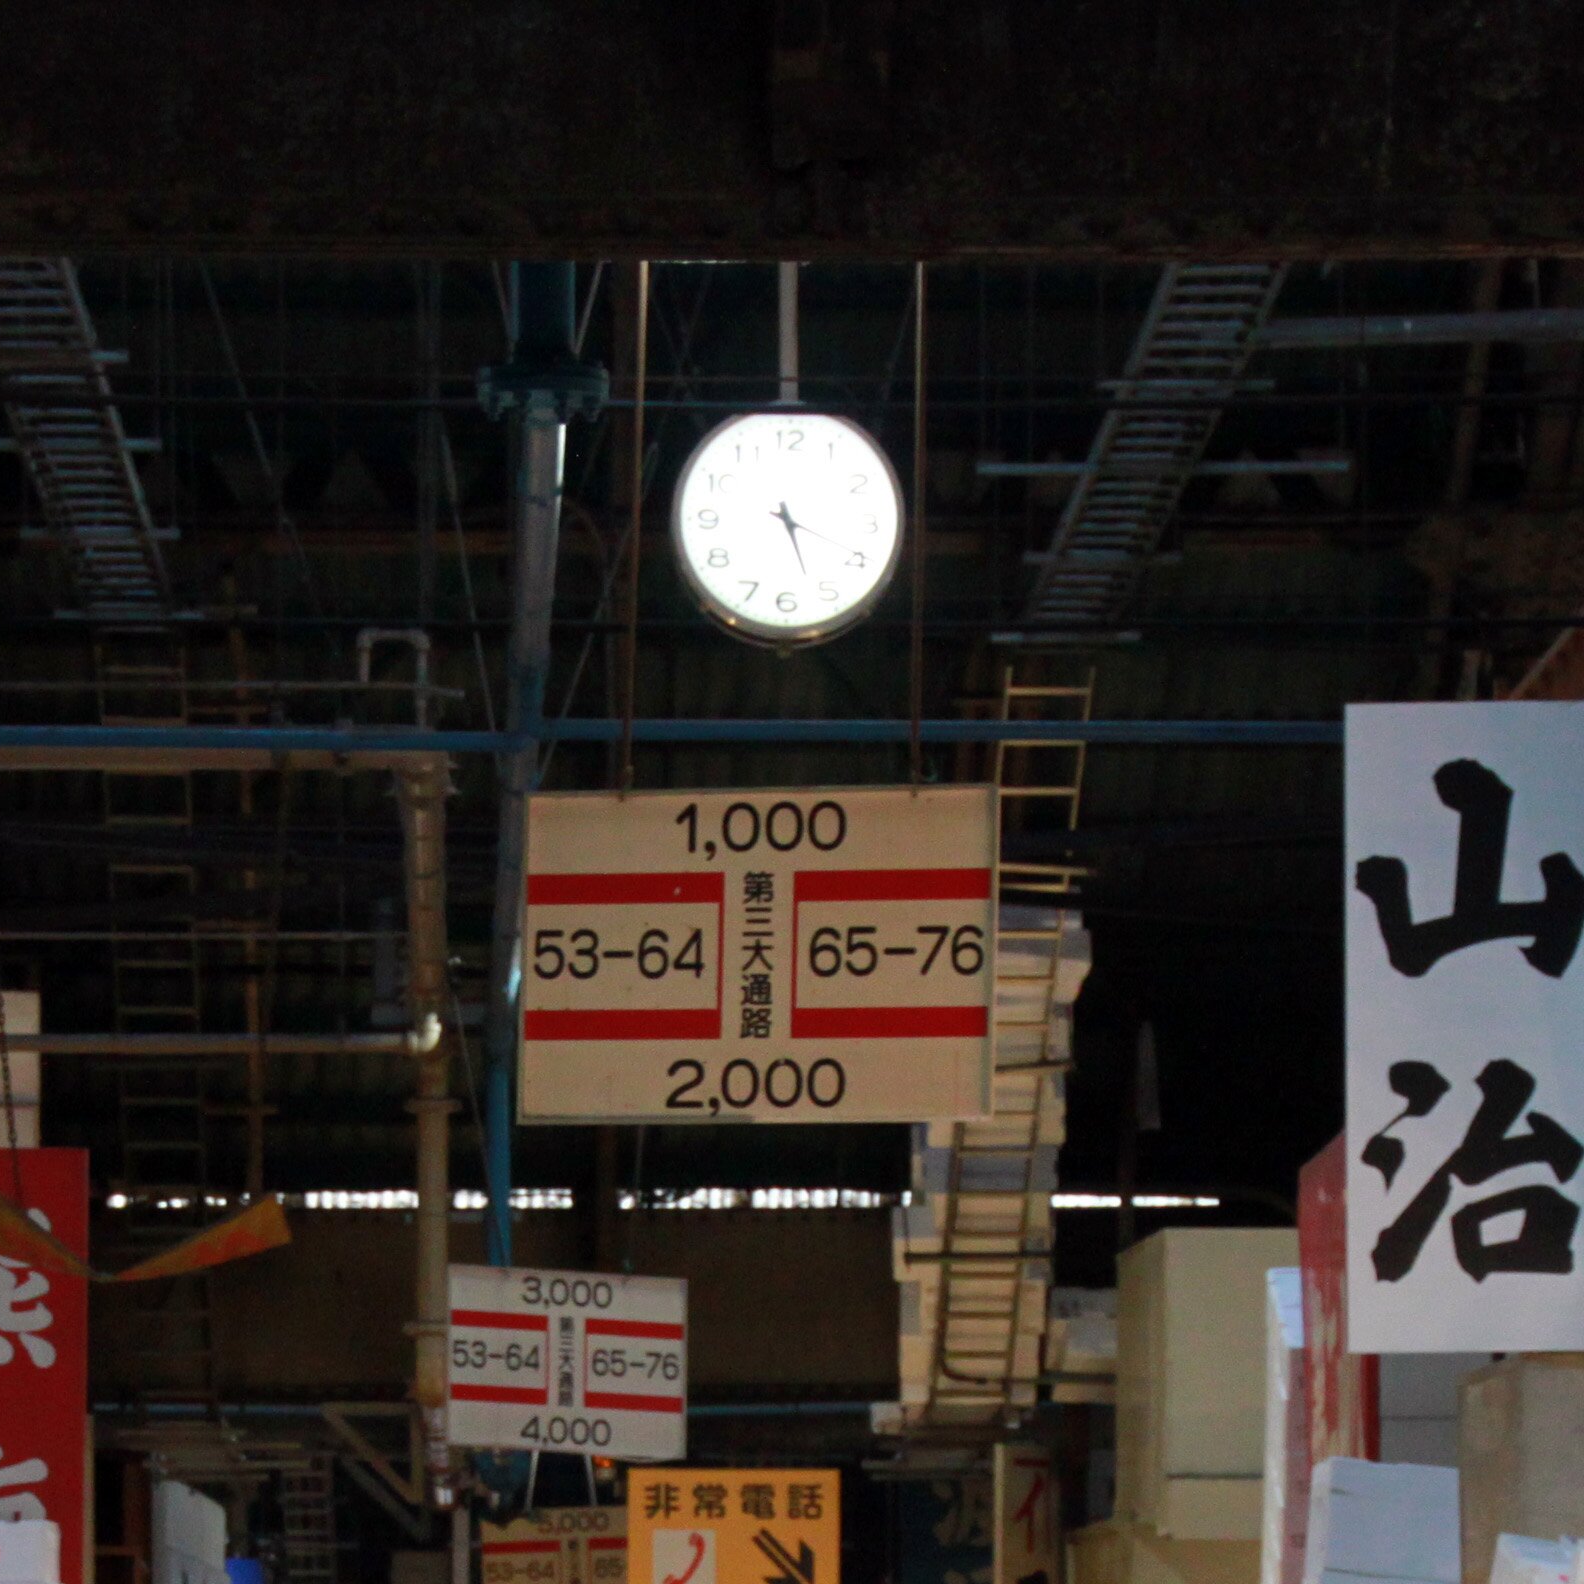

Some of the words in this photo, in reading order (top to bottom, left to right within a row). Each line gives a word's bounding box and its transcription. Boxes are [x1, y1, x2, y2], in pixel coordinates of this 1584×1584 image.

[735, 444, 760, 464] 11
[775, 429, 805, 452] 12
[827, 442, 834, 461] 1
[849, 474, 869, 494] 2
[697, 509, 720, 530] 9
[863, 513, 879, 534] 3
[707, 547, 730, 568] 8
[737, 580, 760, 602] 7
[775, 591, 798, 613] 6
[818, 580, 839, 602] 5
[674, 801, 848, 860] 1,000
[533, 927, 706, 980] 53-64
[741, 870, 775, 1040] 第三大通路
[808, 925, 985, 978] 65-76
[665, 1058, 847, 1116] 2,000
[521, 1276, 614, 1310] 3,000
[451, 1340, 541, 1371] 53-64
[591, 1348, 680, 1382] 65-76
[519, 1416, 613, 1448] 4,000
[643, 1482, 825, 1522] 非常電話
